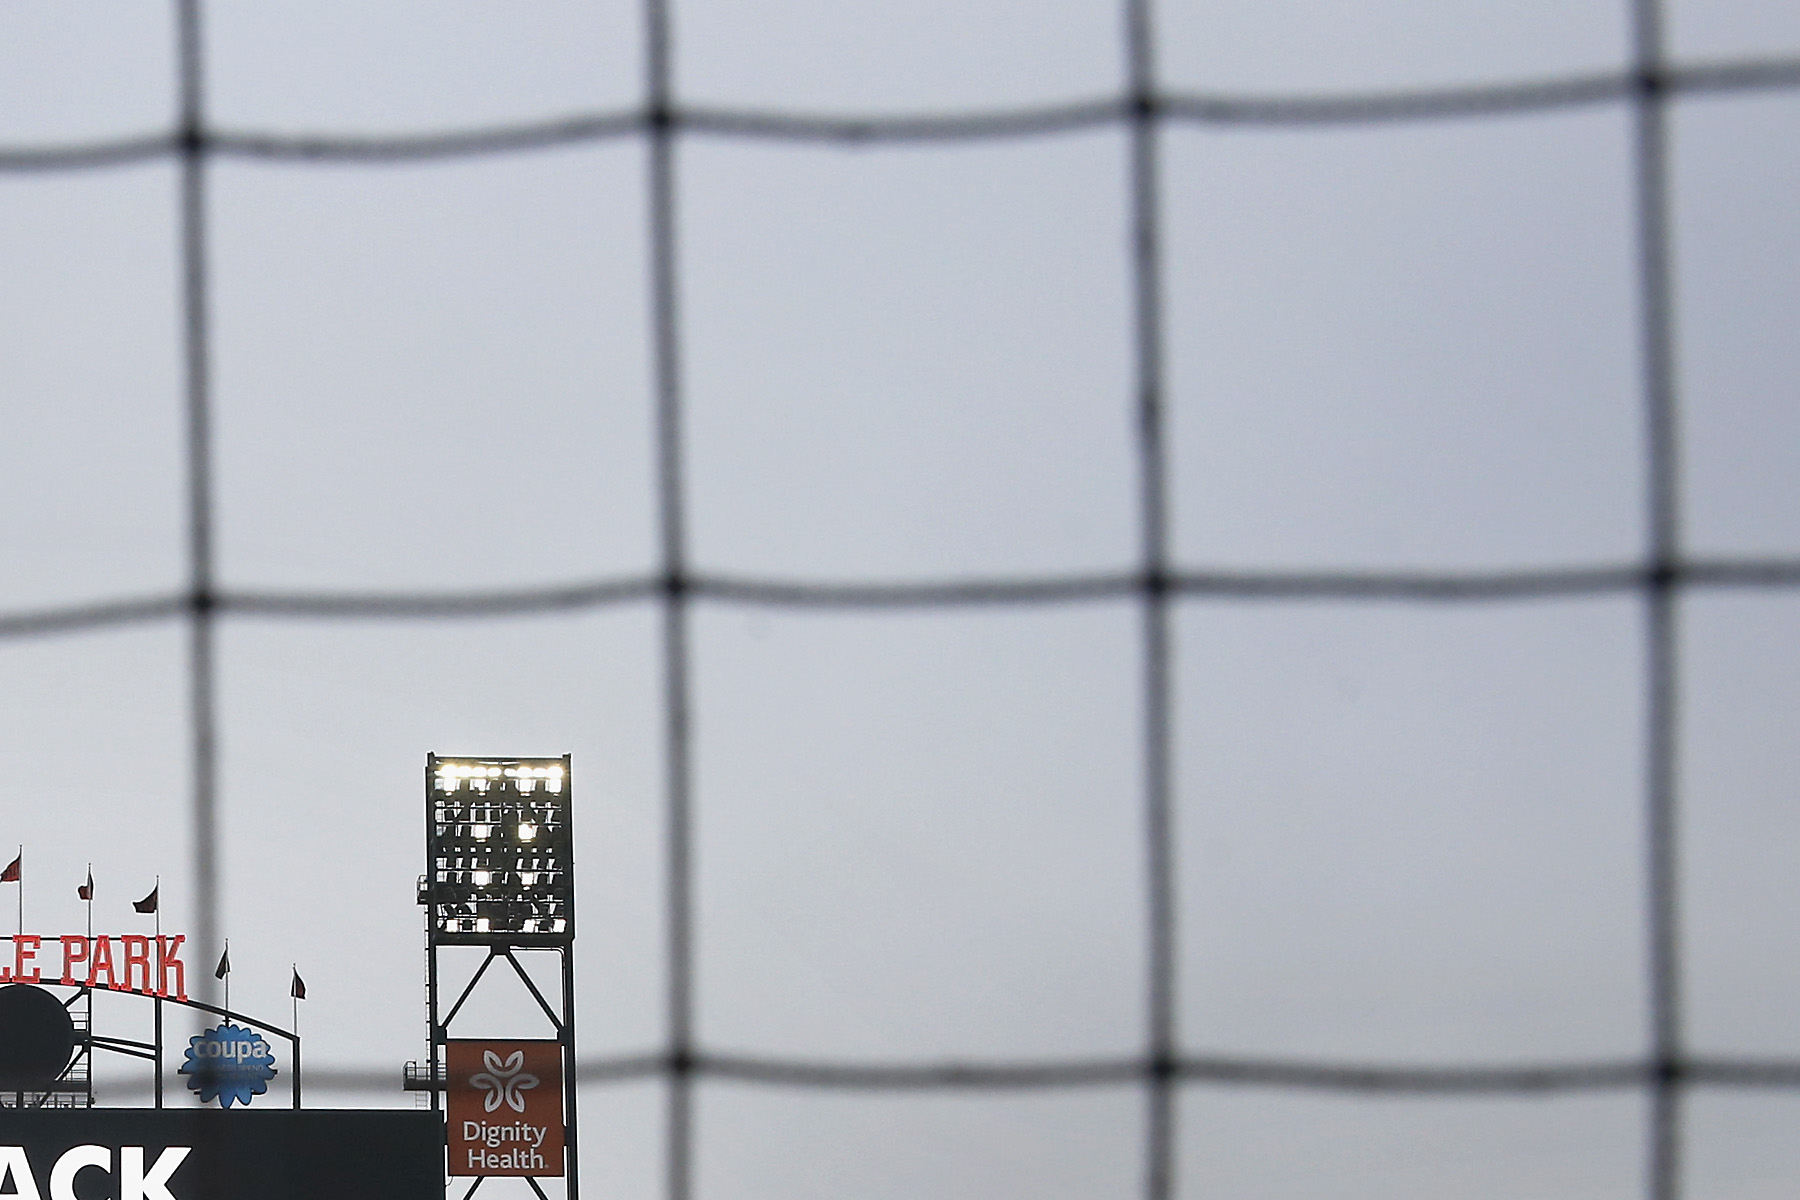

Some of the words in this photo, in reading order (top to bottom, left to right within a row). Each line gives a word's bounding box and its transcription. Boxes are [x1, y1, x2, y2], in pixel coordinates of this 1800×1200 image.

[60, 934, 188, 1003] PARK
[193, 1040, 268, 1065] coupa
[463, 1120, 547, 1148] Dignity
[468, 1147, 544, 1169] Health
